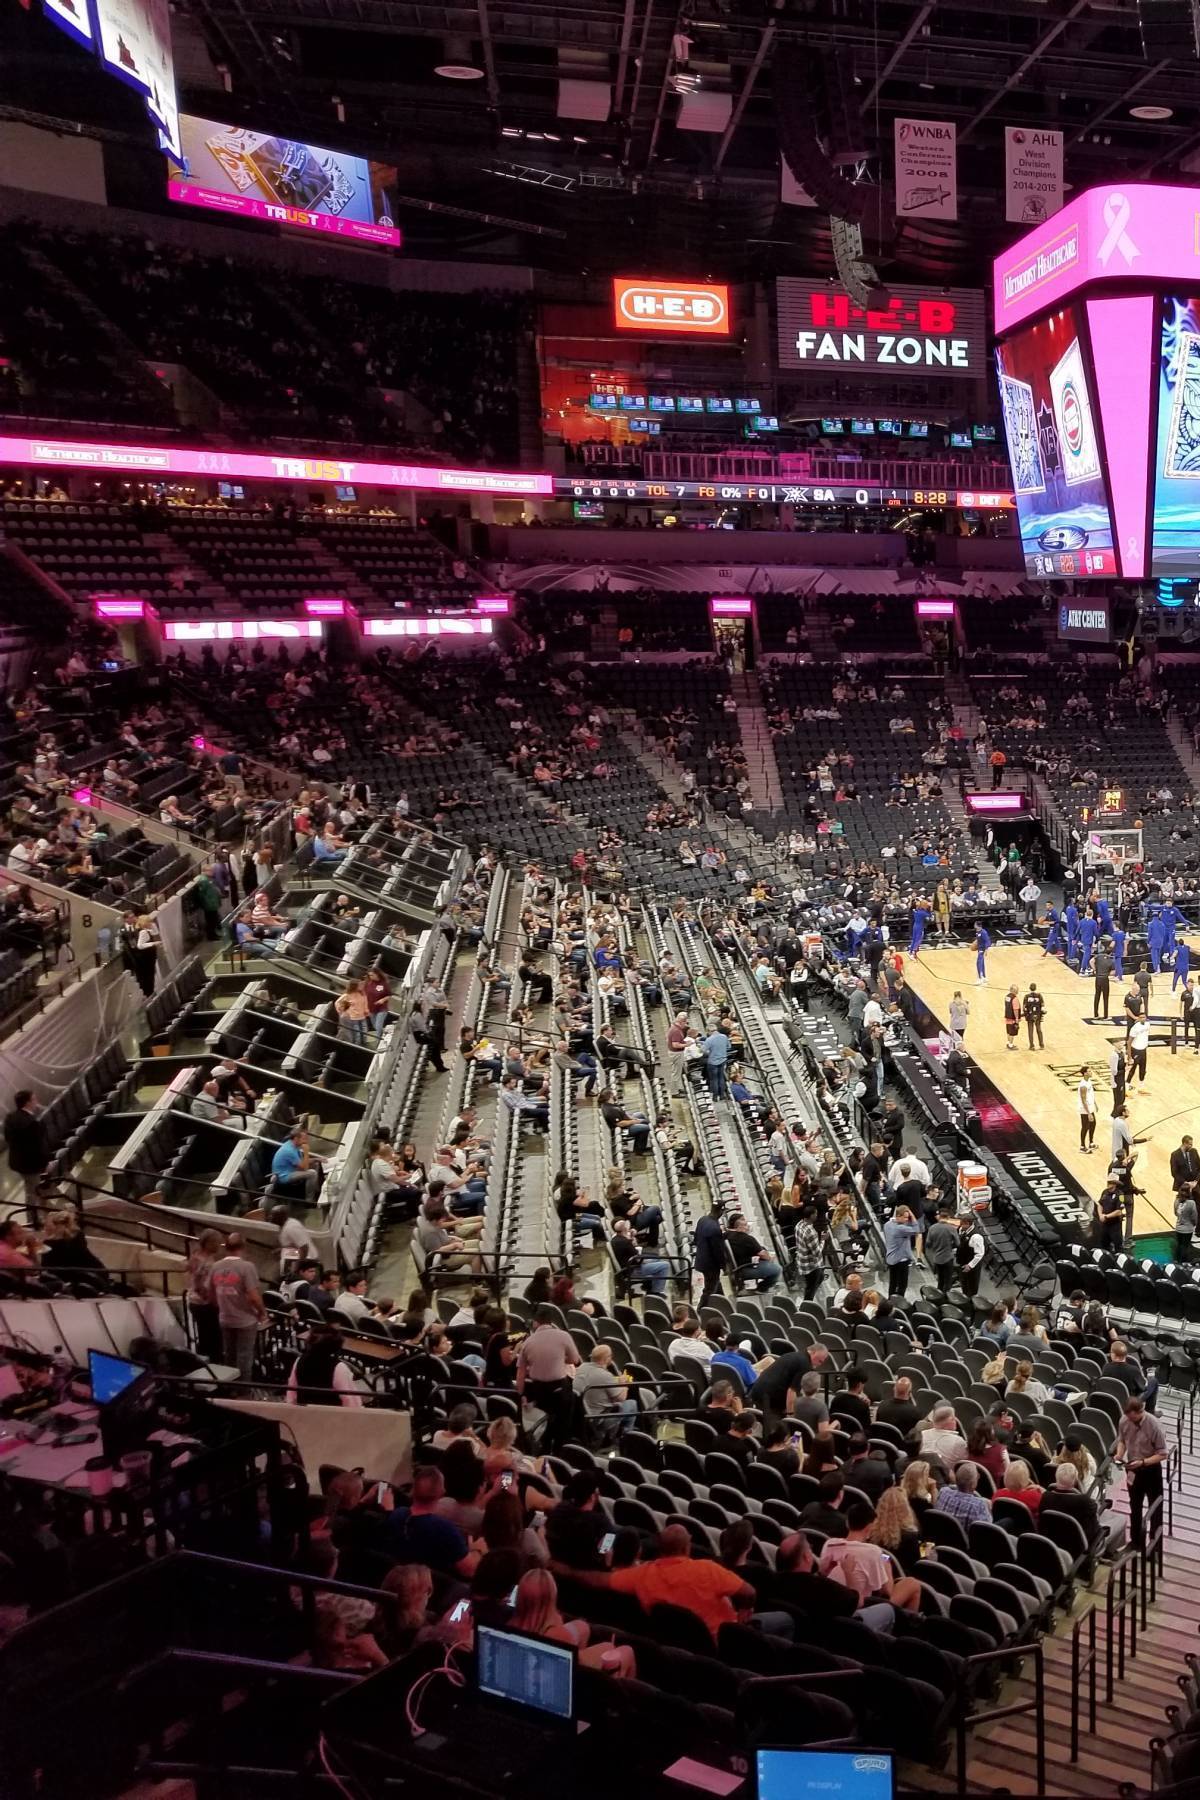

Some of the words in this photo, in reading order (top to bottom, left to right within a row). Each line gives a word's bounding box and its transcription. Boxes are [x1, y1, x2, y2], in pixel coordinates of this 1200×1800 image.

[912, 125, 953, 140] WNBA
[1032, 135, 1058, 146] AHL
[908, 144, 944, 152] Western
[900, 151, 952, 159] Conference
[1024, 150, 1045, 158] West
[901, 158, 951, 166] Champions
[1019, 159, 1051, 169] Division
[905, 169, 949, 178] 2008
[1013, 168, 1057, 179] Champions
[1013, 181, 1057, 192] 2014-2015
[264, 204, 319, 226] TRUST
[633, 295, 714, 319] H-E-B
[796, 332, 865, 361] FAN
[877, 336, 970, 367] ZONE
[272, 459, 354, 481] TRUST
[574, 486, 582, 496] 0
[593, 487, 601, 496] 0
[610, 487, 618, 497] 0
[627, 488, 635, 497] 0
[646, 485, 669, 496] TOL
[676, 486, 685, 496] 7
[699, 487, 714, 497] FG
[721, 487, 741, 498] 0%
[748, 488, 755, 498] F
[758, 488, 767, 499] 0
[813, 489, 835, 501] SA
[856, 490, 868, 504] 0
[914, 492, 947, 504] 8:28
[979, 496, 1001, 505] DET
[1082, 610, 1106, 628] CENTER
[273, 781, 288, 791] 14
[1104, 799, 1120, 810] 24
[82, 915, 93, 928] 8
[730, 1755, 748, 1773] 10
